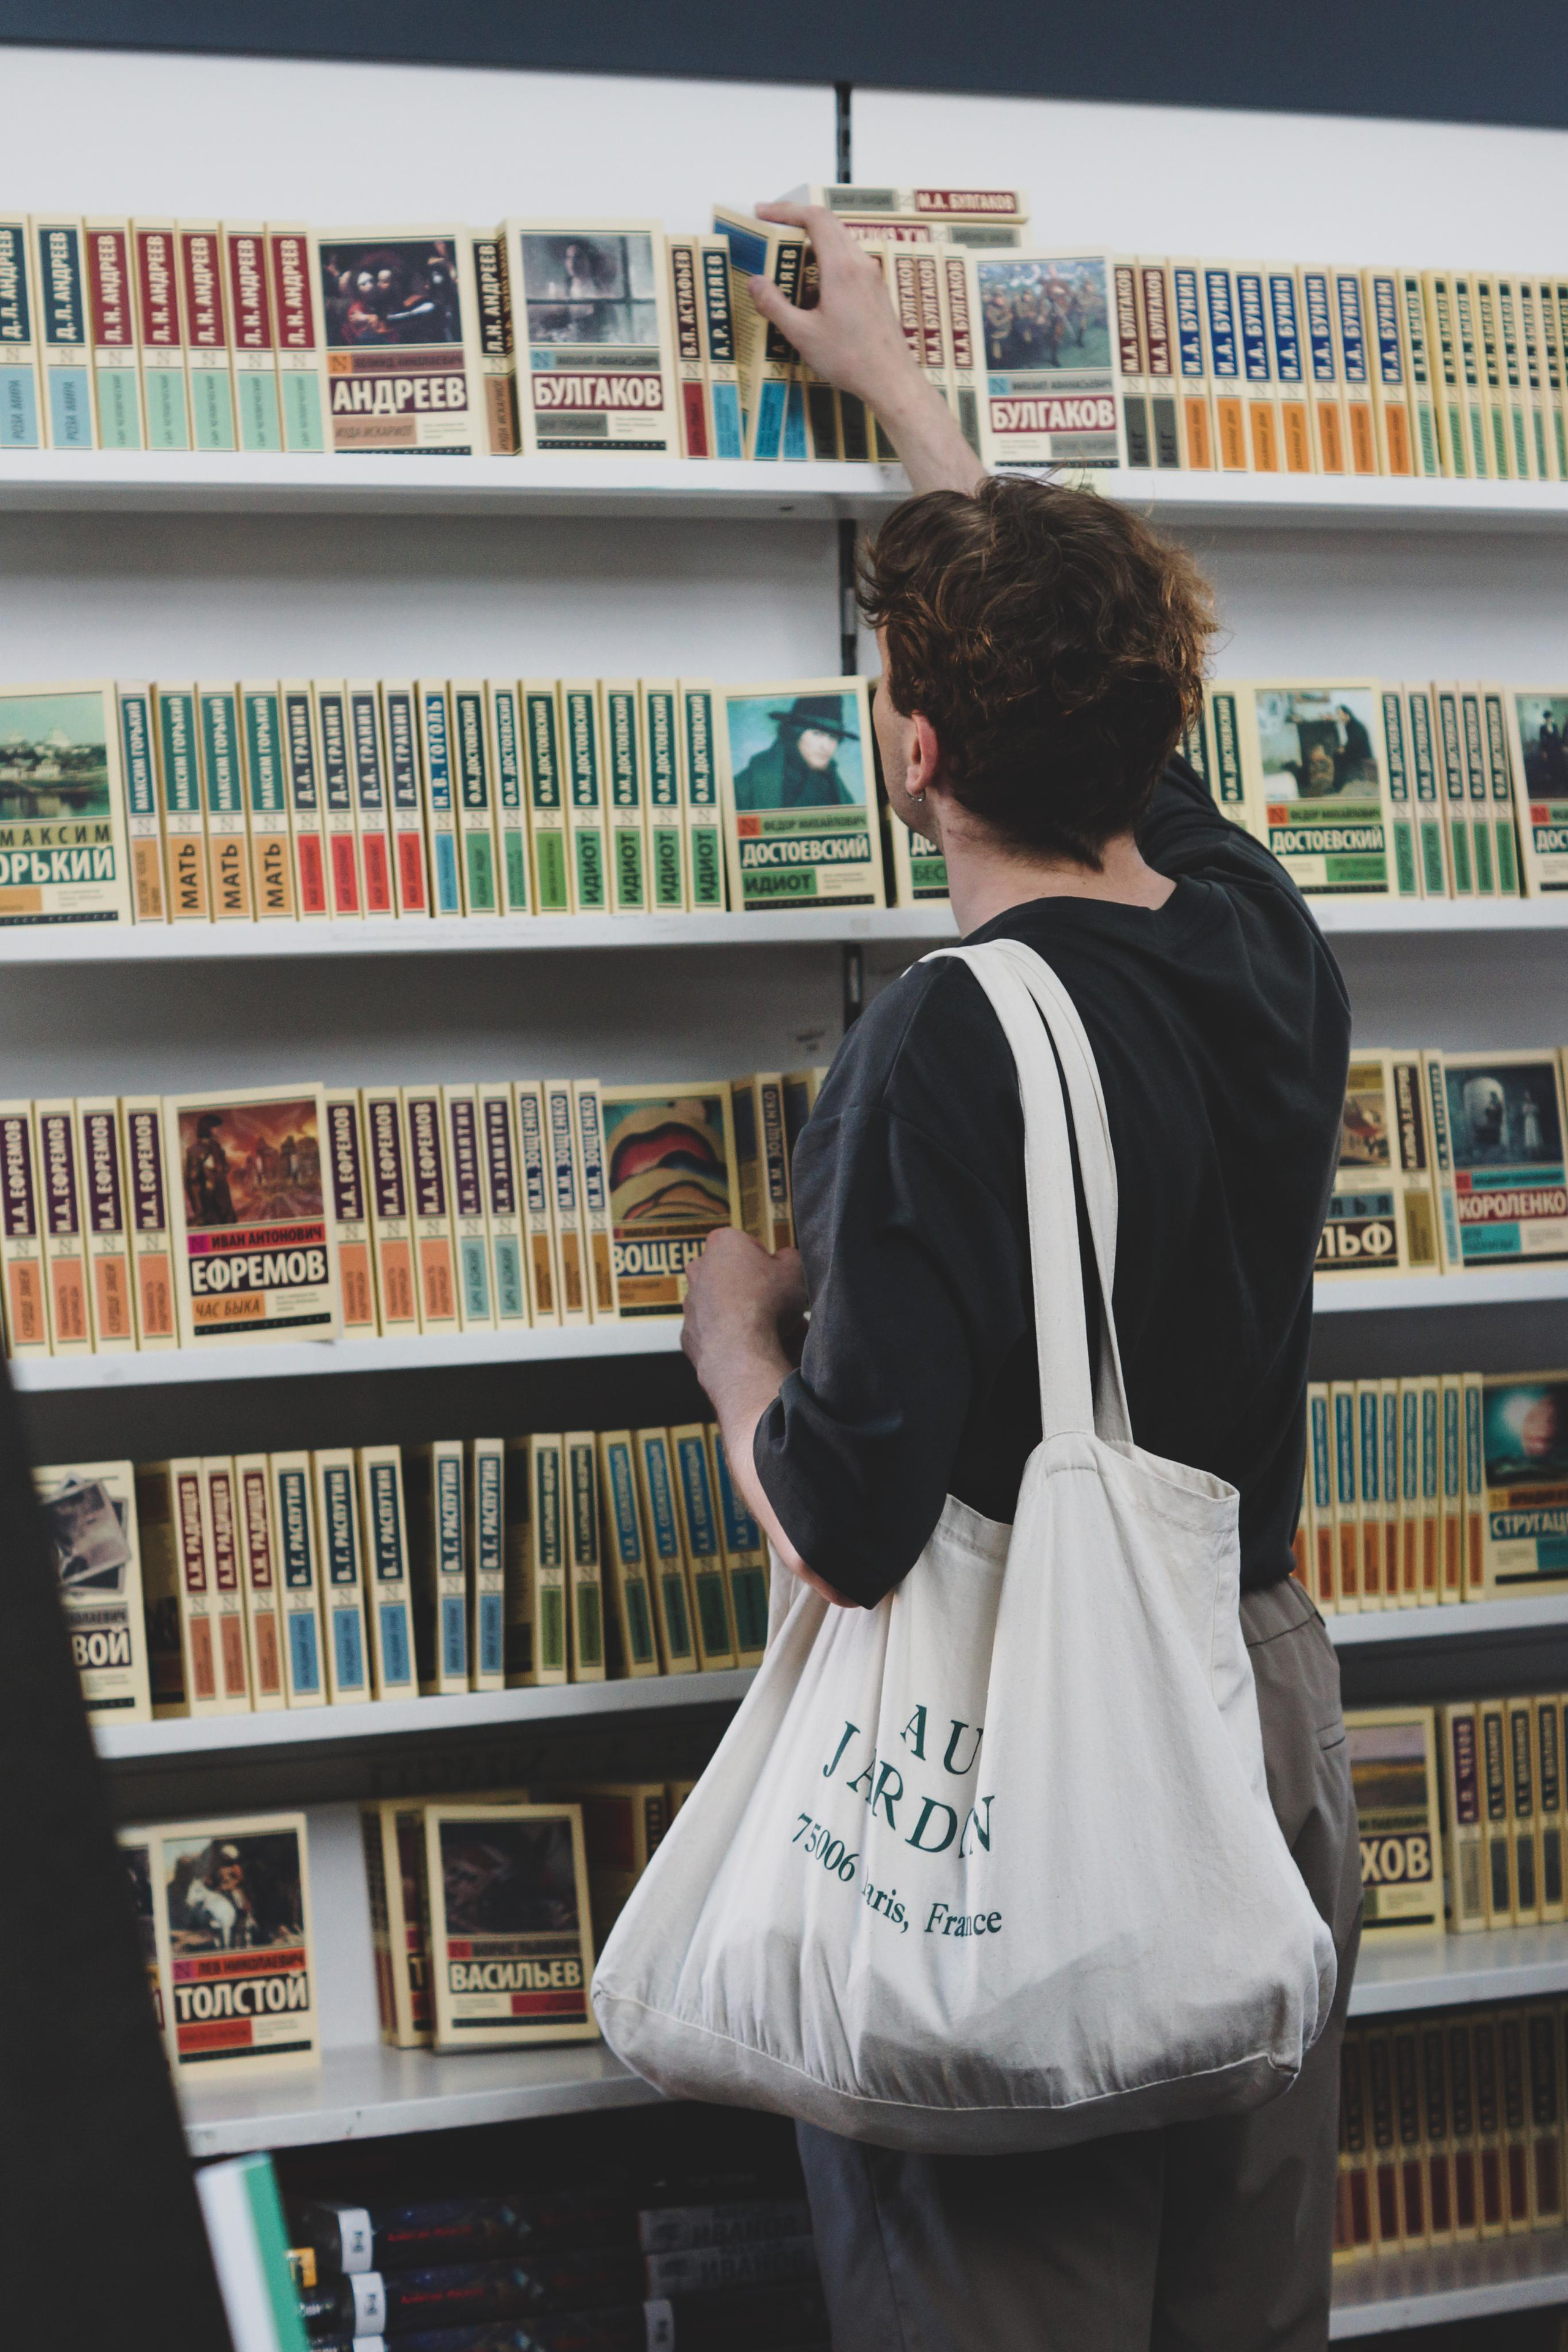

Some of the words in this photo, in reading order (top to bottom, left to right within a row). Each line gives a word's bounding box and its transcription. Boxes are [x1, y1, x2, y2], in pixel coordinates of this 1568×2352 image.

[0, 230, 20, 299] АНДРЕЕВ
[49, 232, 74, 301] АНДРЕЕВ
[96, 235, 123, 303] АНДРЕЕВ
[146, 235, 170, 303] АНДРЕЕВ
[190, 236, 216, 304] АНДРЕЕВ
[236, 239, 262, 307] АНДРЕЕВ
[280, 239, 306, 306] АНДРЕЕВ
[478, 244, 502, 315] АНДРЕЕВ
[675, 251, 694, 323] АСТАФЬЕВ
[706, 255, 726, 318] БЕЛЯЕВ
[896, 258, 918, 327] БУЛГАКОВ
[918, 260, 940, 328] БУЛГАКОВ
[946, 262, 968, 330] БУЛГАКОВ
[1115, 269, 1137, 337] БУЛГАКОВ
[1144, 271, 1167, 338] БУЛГАКОВ
[1175, 273, 1197, 331] БУНИН
[1208, 274, 1231, 332] БУНИН
[1239, 279, 1263, 336] БУНИН
[1272, 279, 1295, 337] БУНИН
[1306, 278, 1329, 336] БУНИН
[1339, 280, 1360, 338] БУНИН
[1376, 282, 1396, 339] БУНИН
[333, 377, 466, 414] АНДРЕЕВ
[534, 377, 662, 407] БУЛГАКОВ
[992, 400, 1115, 429] БУЛГАКОВ
[126, 702, 144, 755] ГОРЬКИЙ
[168, 698, 186, 753] ГОРЬКИЙ
[209, 699, 228, 753] ГОРЬКИЙ
[252, 698, 271, 753] ГОРЬКИЙ
[290, 705, 309, 764] ГРАНИН
[325, 706, 342, 764] ГРАНИН
[356, 704, 374, 763] ГРАНИН
[391, 704, 410, 762] ГРАНИН
[426, 701, 445, 763] ГОГОЛЬ
[461, 700, 481, 775] ДОСТОЕВСКИЙ
[497, 697, 516, 774] ДОСТОЕВСКИЙ
[533, 701, 552, 774] ДОСТОЕВСКИЙ
[570, 696, 592, 774] ДОСТОЕВСКИЙ
[612, 697, 633, 774] ДОСТОЕВСКИЙ
[651, 696, 671, 773] ДОСТОЕВСКИЙ
[689, 696, 709, 772] ДОСТОЕВСКИЙ
[131, 758, 149, 809] МАКСИМ
[173, 756, 190, 809] МАКСИМ
[216, 756, 232, 809] МАКСИМ
[258, 756, 275, 808] МАКСИМ
[0, 844, 113, 883] ОРЬКИЙ
[1, 824, 111, 848] МАКСИМ
[580, 834, 603, 902] ИДИОТ
[620, 833, 641, 901] ИДИОТ
[658, 833, 679, 900] ИДИОТ
[697, 832, 717, 899] ИДИОТ
[743, 835, 869, 868] ДОСТОЕВСКИЙ
[1272, 826, 1383, 855] ДОСТОЕВСКИЙ
[178, 843, 198, 909] МАТЬ
[220, 844, 242, 909] МАТЬ
[263, 843, 285, 907] МАТЬ
[745, 874, 811, 894] ИДИОТ
[4, 1120, 27, 1197] ЕФРЕМОВ
[47, 1118, 70, 1195] ЕФРЕМОВ
[90, 1117, 113, 1193] ЕФРЕМОВ
[135, 1115, 157, 1192] ЕФРЕМОВ
[333, 1107, 355, 1182] ЕФРЕМОВ
[375, 1104, 396, 1178] ЕФРЕМОВ
[415, 1103, 437, 1178] ЕФРЕМОВ
[455, 1105, 474, 1179] ЗАМЯТИН
[489, 1104, 508, 1178] ЗАМЯТИН
[521, 1099, 542, 1167] ЗОЩЕНКО
[551, 1097, 571, 1165] ЗОЩЕНКО
[579, 1098, 601, 1166] ЗОЩЕНКО
[1332, 1196, 1390, 1216] ЛЬЯ
[1459, 1190, 1566, 1220] КОРОЛЕНКО
[212, 1233, 245, 1249] ИВАН
[248, 1227, 323, 1245] АНТОНОВИЧ
[614, 1241, 707, 1276] ЗОЩЕН
[1316, 1221, 1393, 1257] ЛЬФ
[192, 1250, 326, 1292] ЕФРЕМОВ
[196, 1303, 221, 1317] ЧАС
[224, 1300, 260, 1316] БЫКА
[1493, 1512, 1568, 1537] СТРУГАЦ
[900, 1705, 983, 1775] AU
[823, 1721, 995, 1858] JARDN
[793, 1813, 859, 1882] 75006
[862, 1866, 909, 1933] aris,
[924, 1903, 1002, 1937] France
[1359, 1837, 1430, 1882] ХОВ
[175, 1969, 306, 2021] ТОЛСТОЙ
[452, 1960, 581, 1991] ВАСИЛЬЕВ
